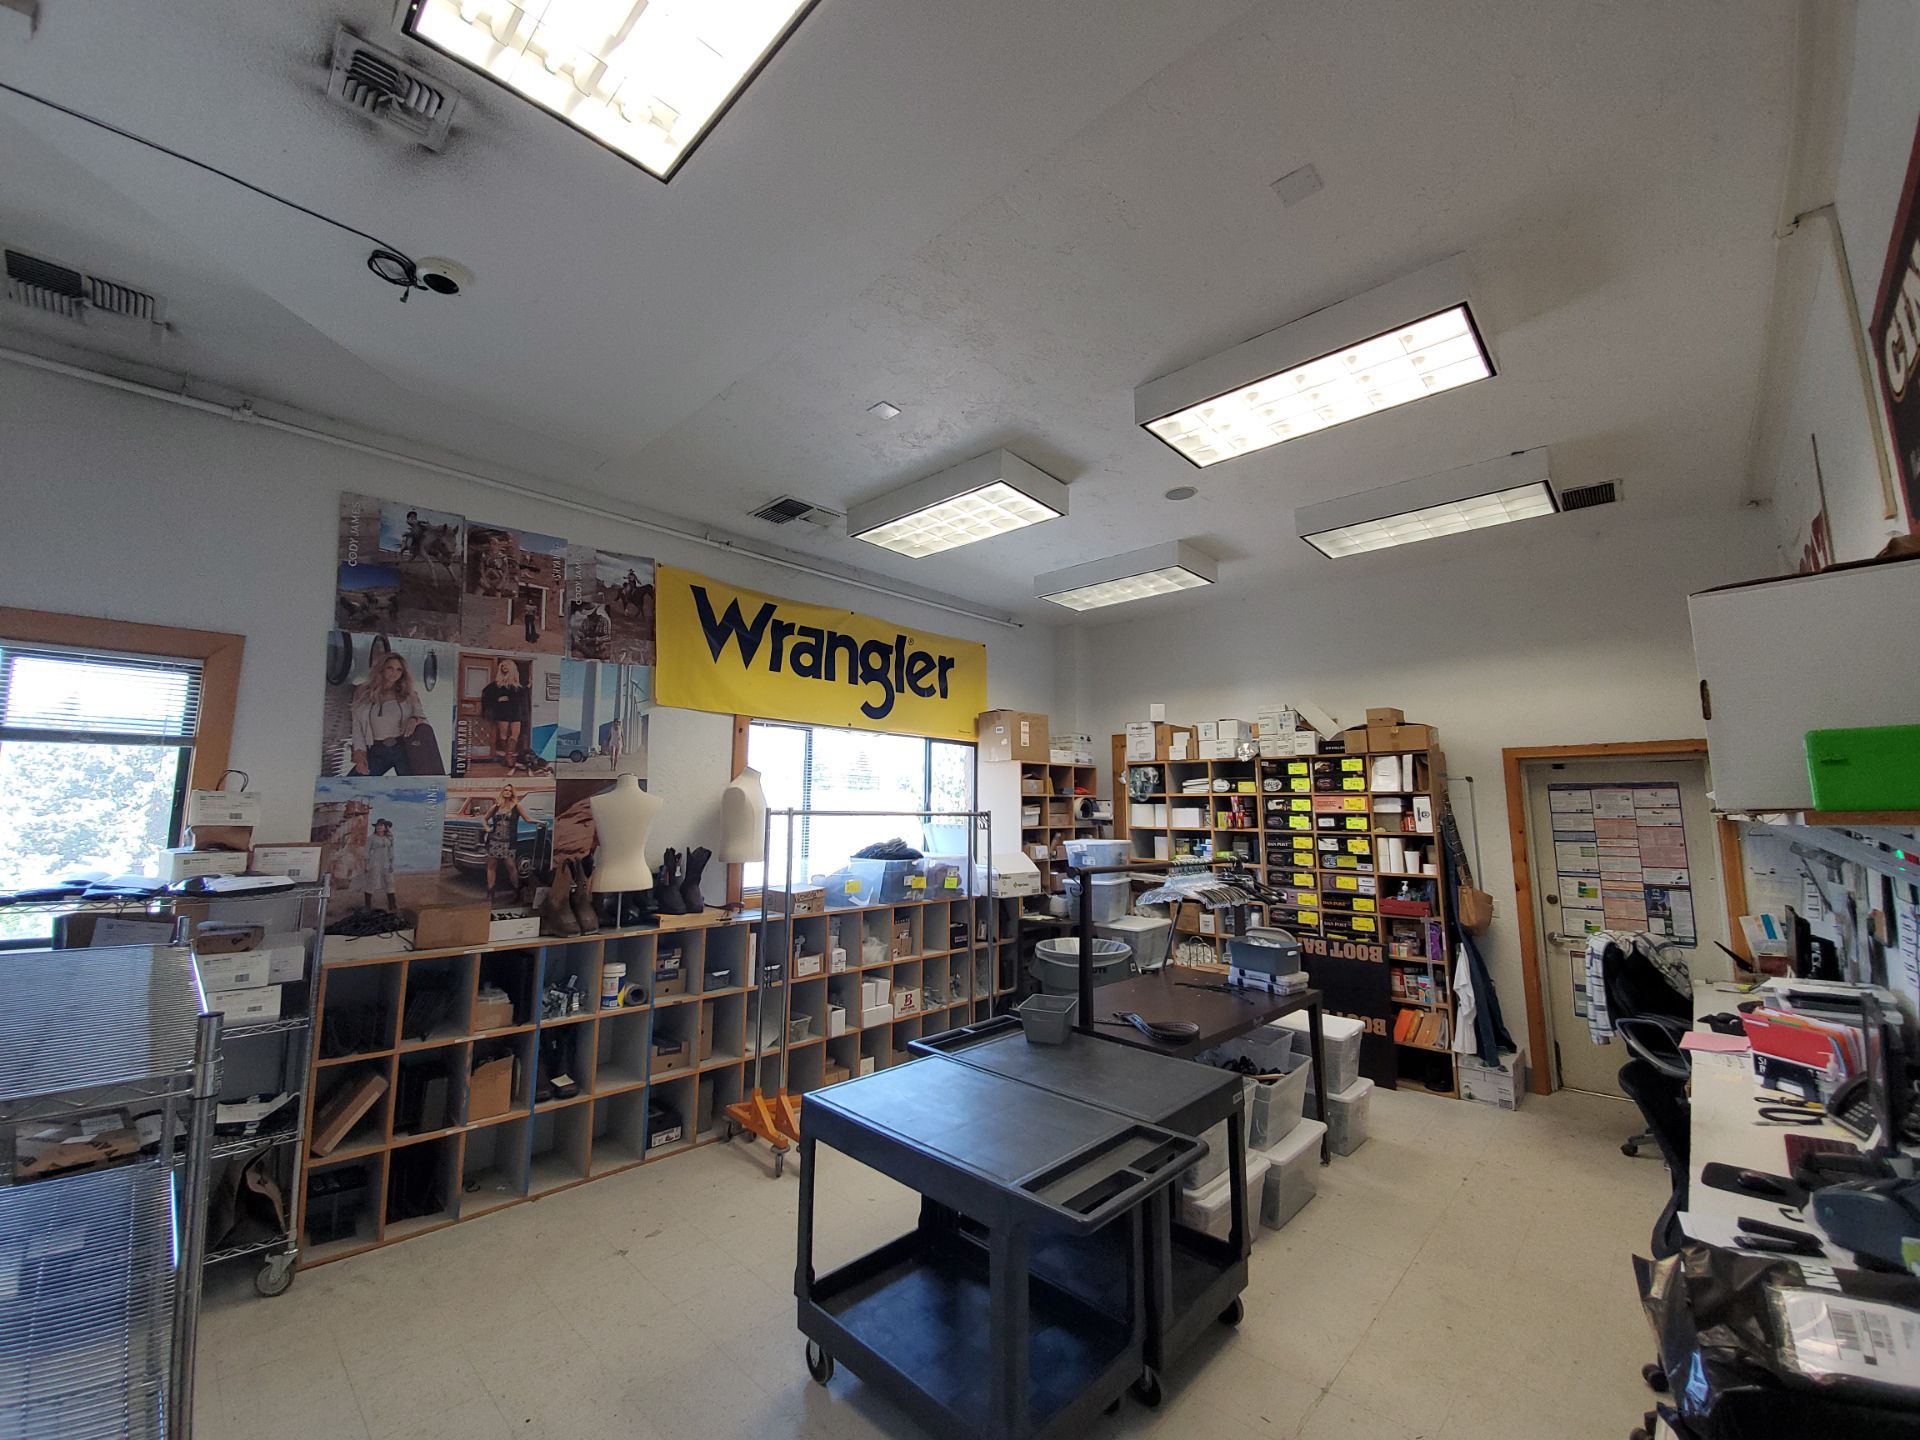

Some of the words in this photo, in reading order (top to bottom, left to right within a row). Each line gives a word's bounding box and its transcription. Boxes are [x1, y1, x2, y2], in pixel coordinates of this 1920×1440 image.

[351, 502, 361, 537] JAMES
[348, 538, 359, 567] CODY
[575, 581, 583, 605] CODY
[689, 584, 954, 720] Wrangler
[456, 720, 468, 774] IDYLLWIND
[1330, 941, 1383, 963] BOOT
